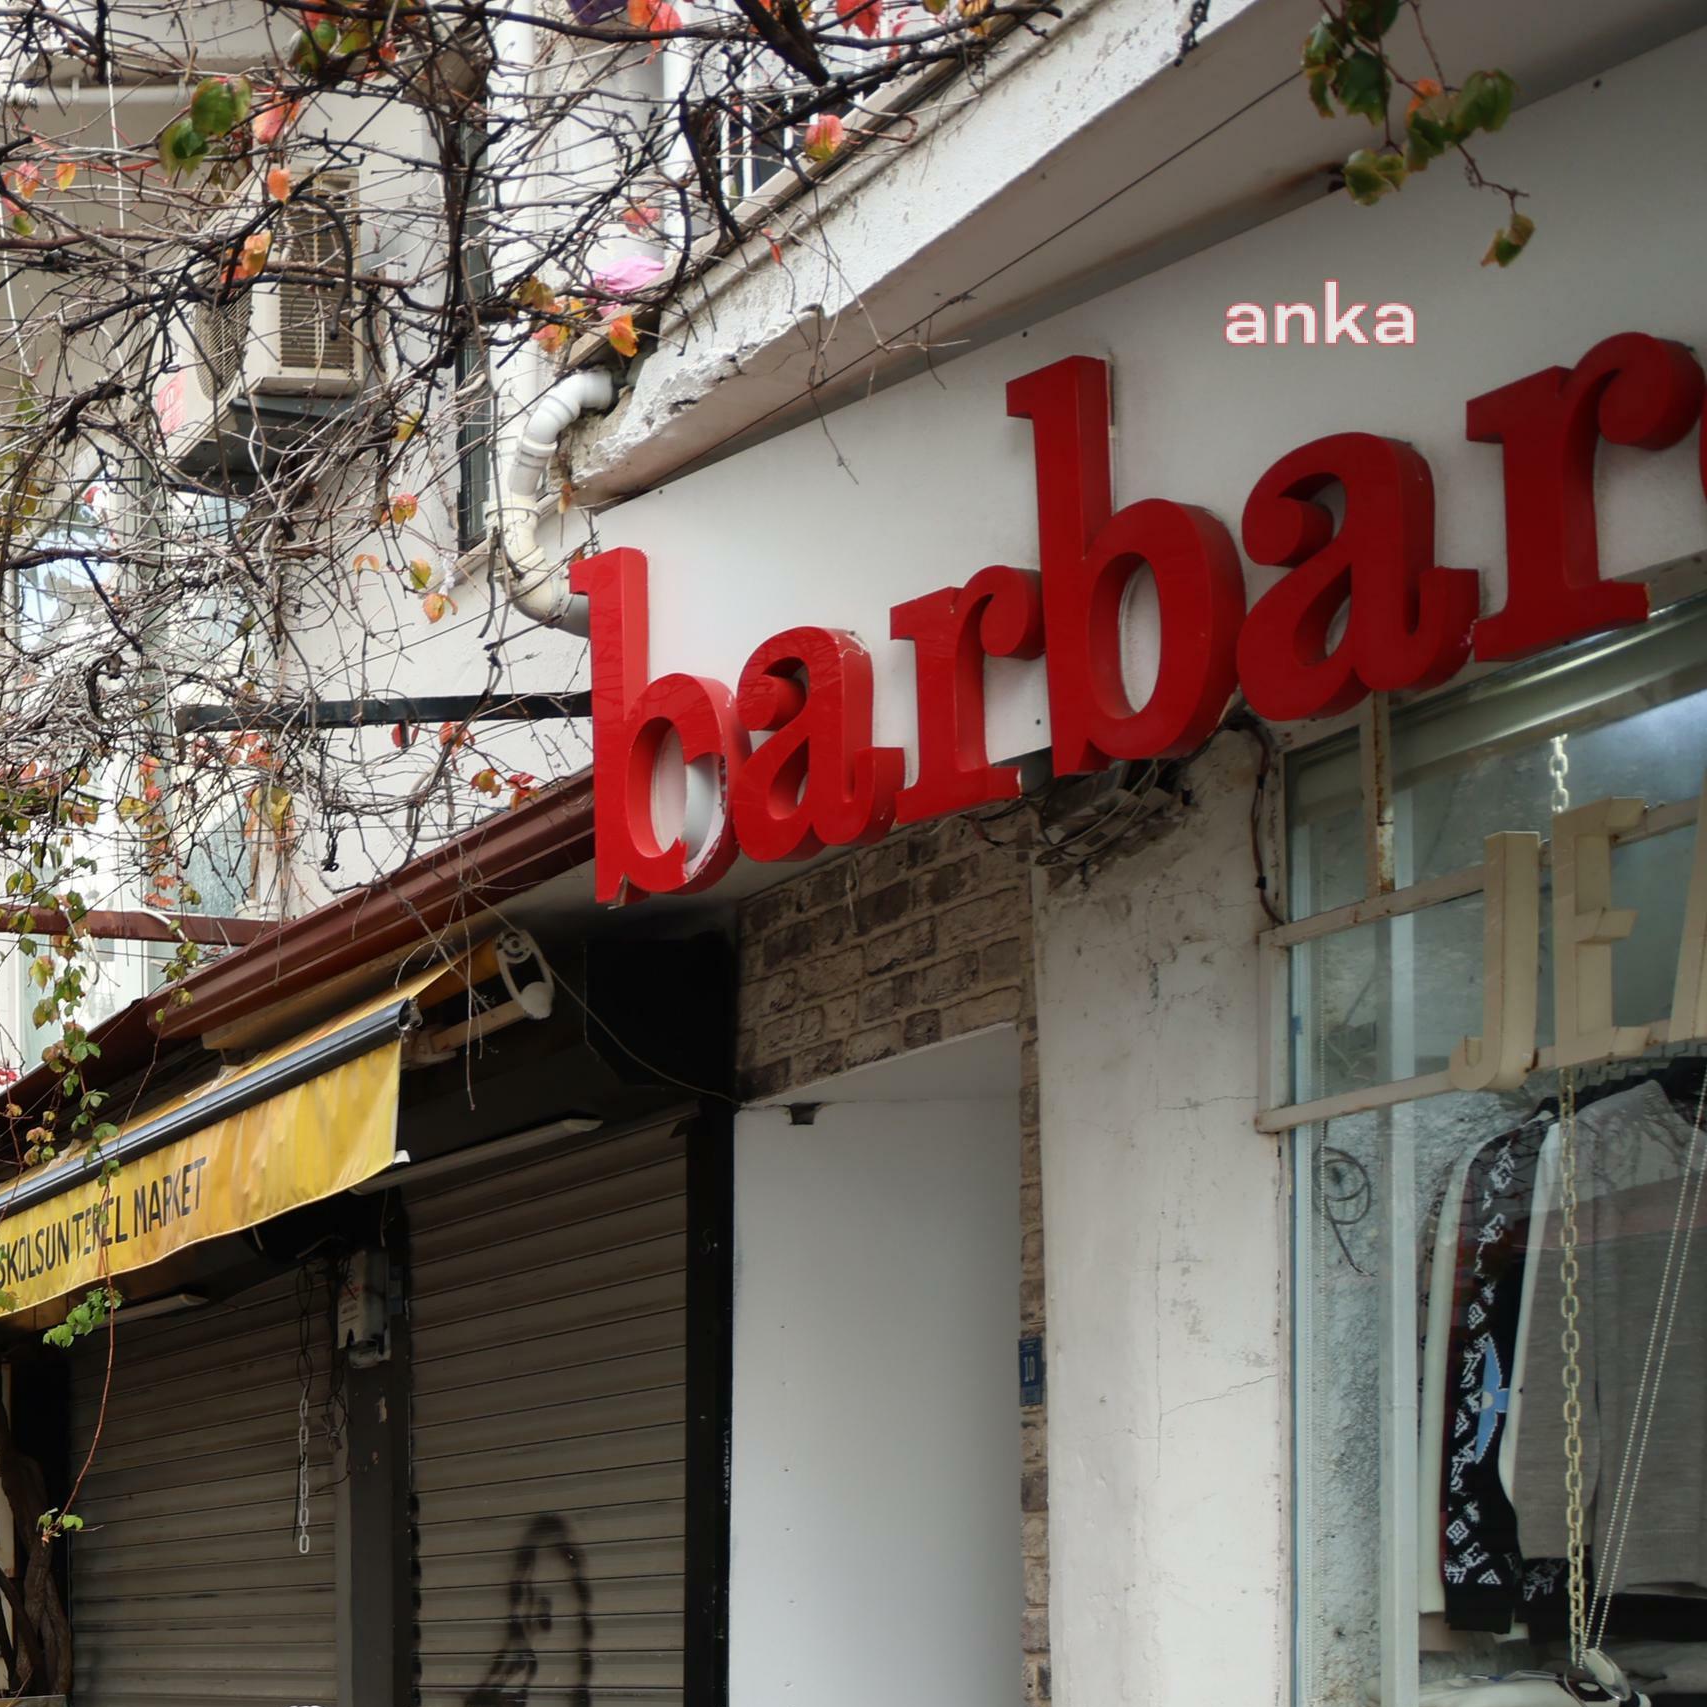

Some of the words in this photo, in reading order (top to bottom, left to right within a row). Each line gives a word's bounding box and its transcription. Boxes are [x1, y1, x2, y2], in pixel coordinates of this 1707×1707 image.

[570, 330, 1707, 906] barbar
[1449, 767, 1707, 1091] JE
[133, 1156, 208, 1238] MARKET
